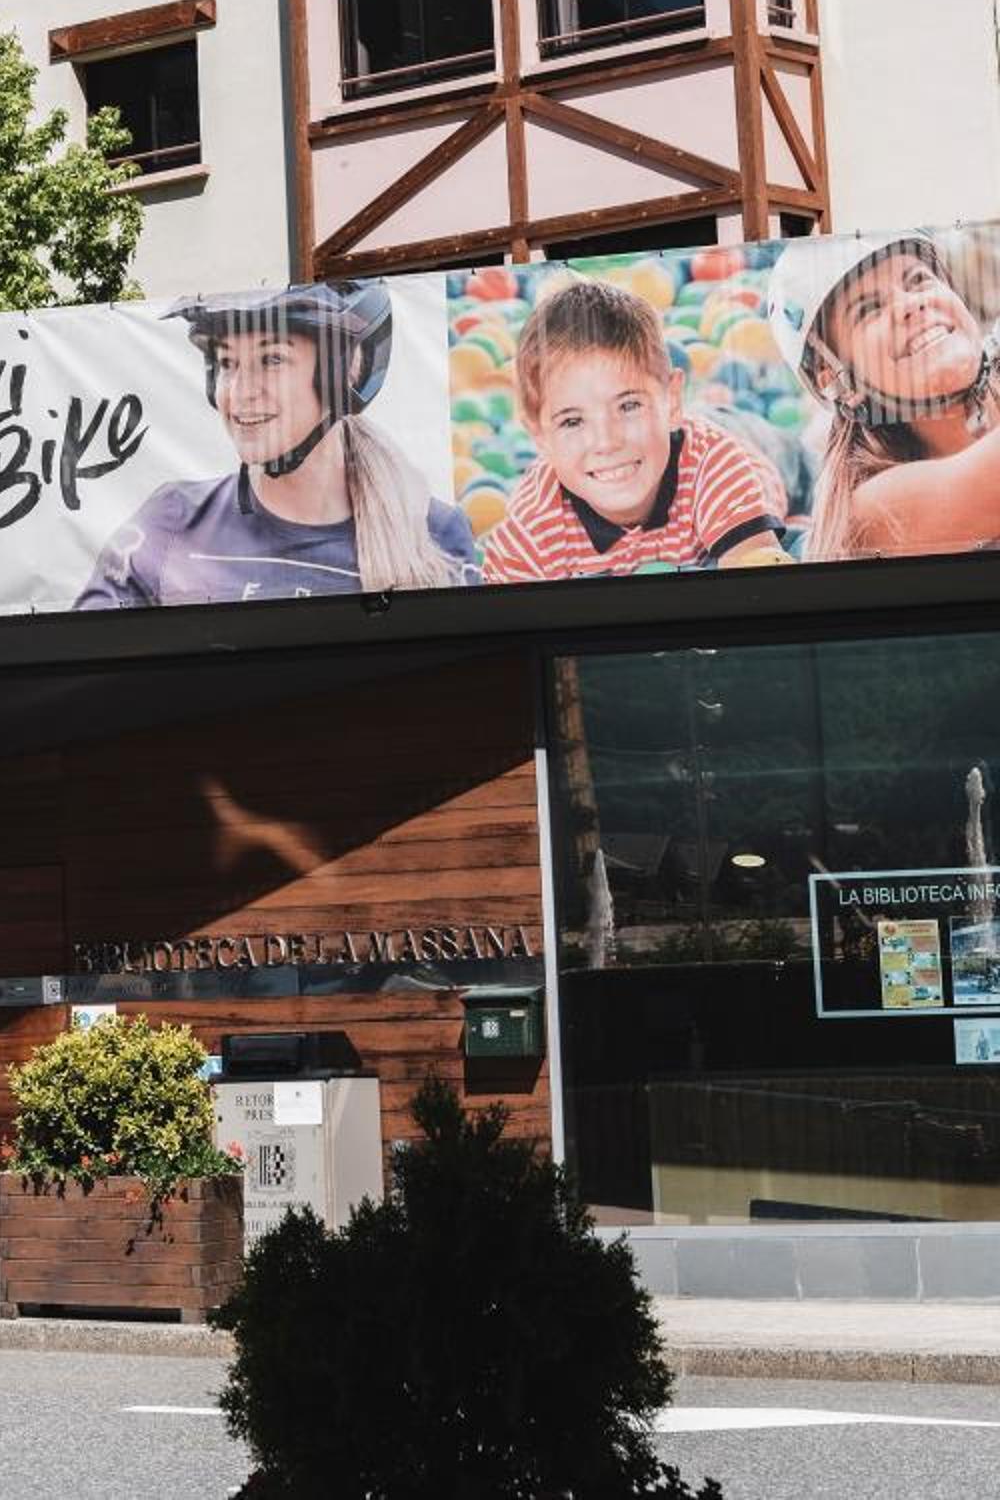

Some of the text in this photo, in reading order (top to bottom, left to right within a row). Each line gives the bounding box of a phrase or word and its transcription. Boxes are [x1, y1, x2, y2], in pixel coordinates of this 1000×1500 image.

[839, 887, 861, 905] LA
[863, 884, 965, 905] BIBLIOTECA
[369, 925, 534, 963] MASSANA
[235, 1093, 275, 1107] RETOR
